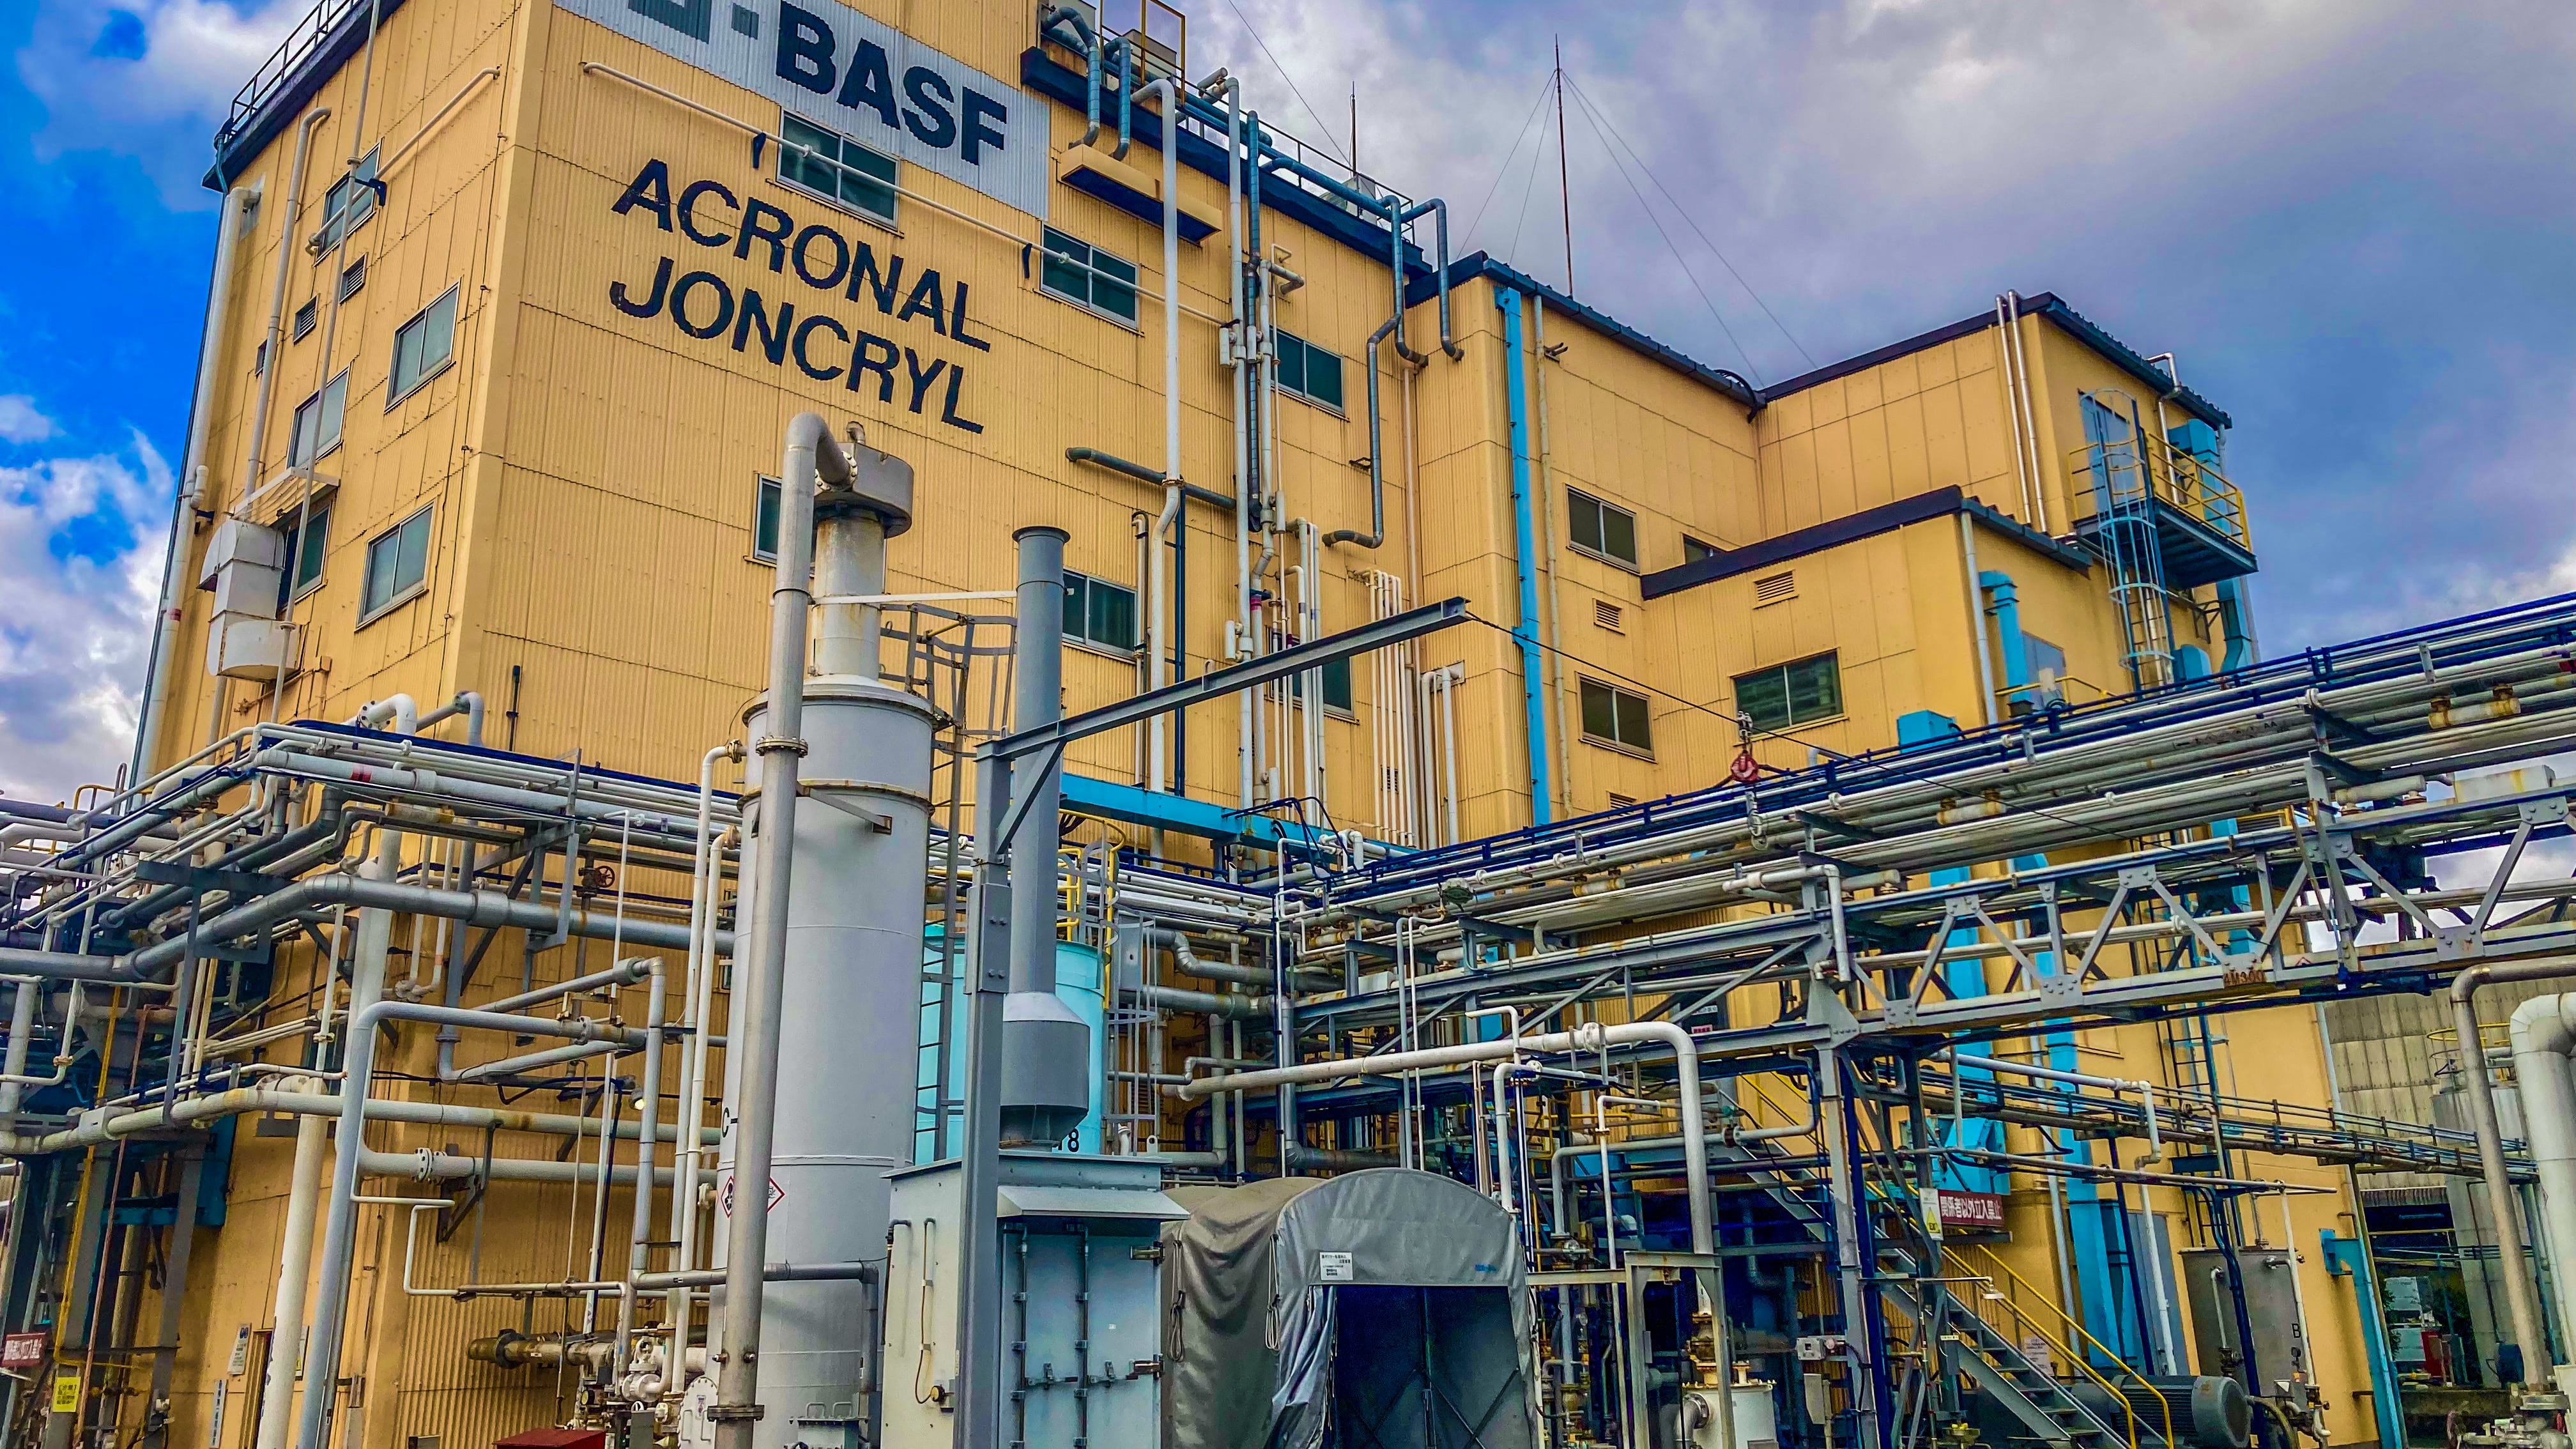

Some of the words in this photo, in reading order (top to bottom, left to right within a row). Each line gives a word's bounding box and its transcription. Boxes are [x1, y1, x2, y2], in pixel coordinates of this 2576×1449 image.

[775, 0, 1008, 165] BASF
[611, 158, 991, 353] ACRONAL
[609, 256, 984, 435] JONCRYL
